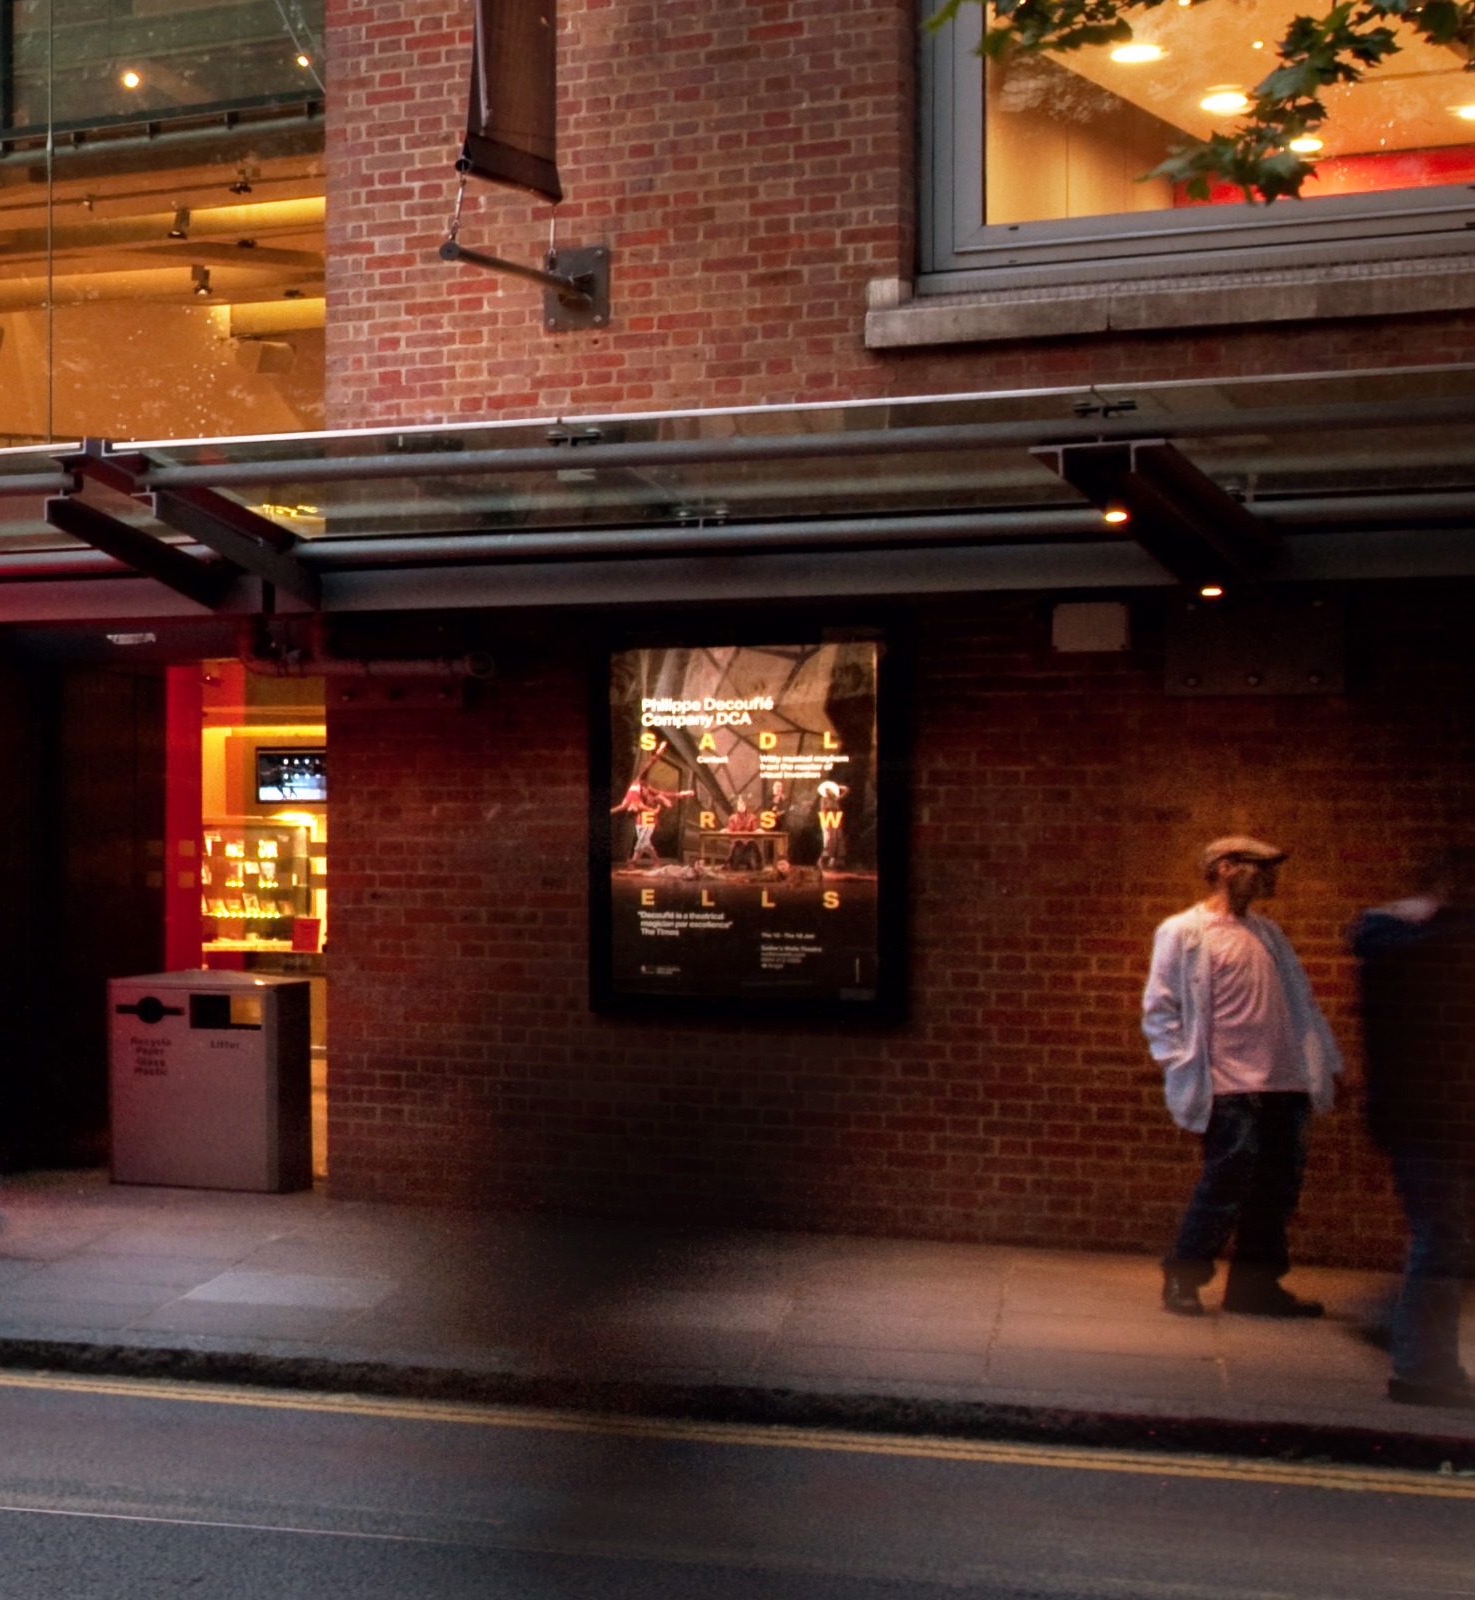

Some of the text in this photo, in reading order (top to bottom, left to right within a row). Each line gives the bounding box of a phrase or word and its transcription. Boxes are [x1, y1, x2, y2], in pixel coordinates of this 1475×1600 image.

[641, 696, 774, 714] Philippe Decouflé
[641, 711, 753, 728] Company DCA
[640, 731, 838, 751] S A D L
[700, 811, 716, 828] R
[760, 811, 776, 828] S
[818, 811, 843, 829] W
[641, 888, 840, 909] E L L S
[210, 1040, 240, 1049] Litter
